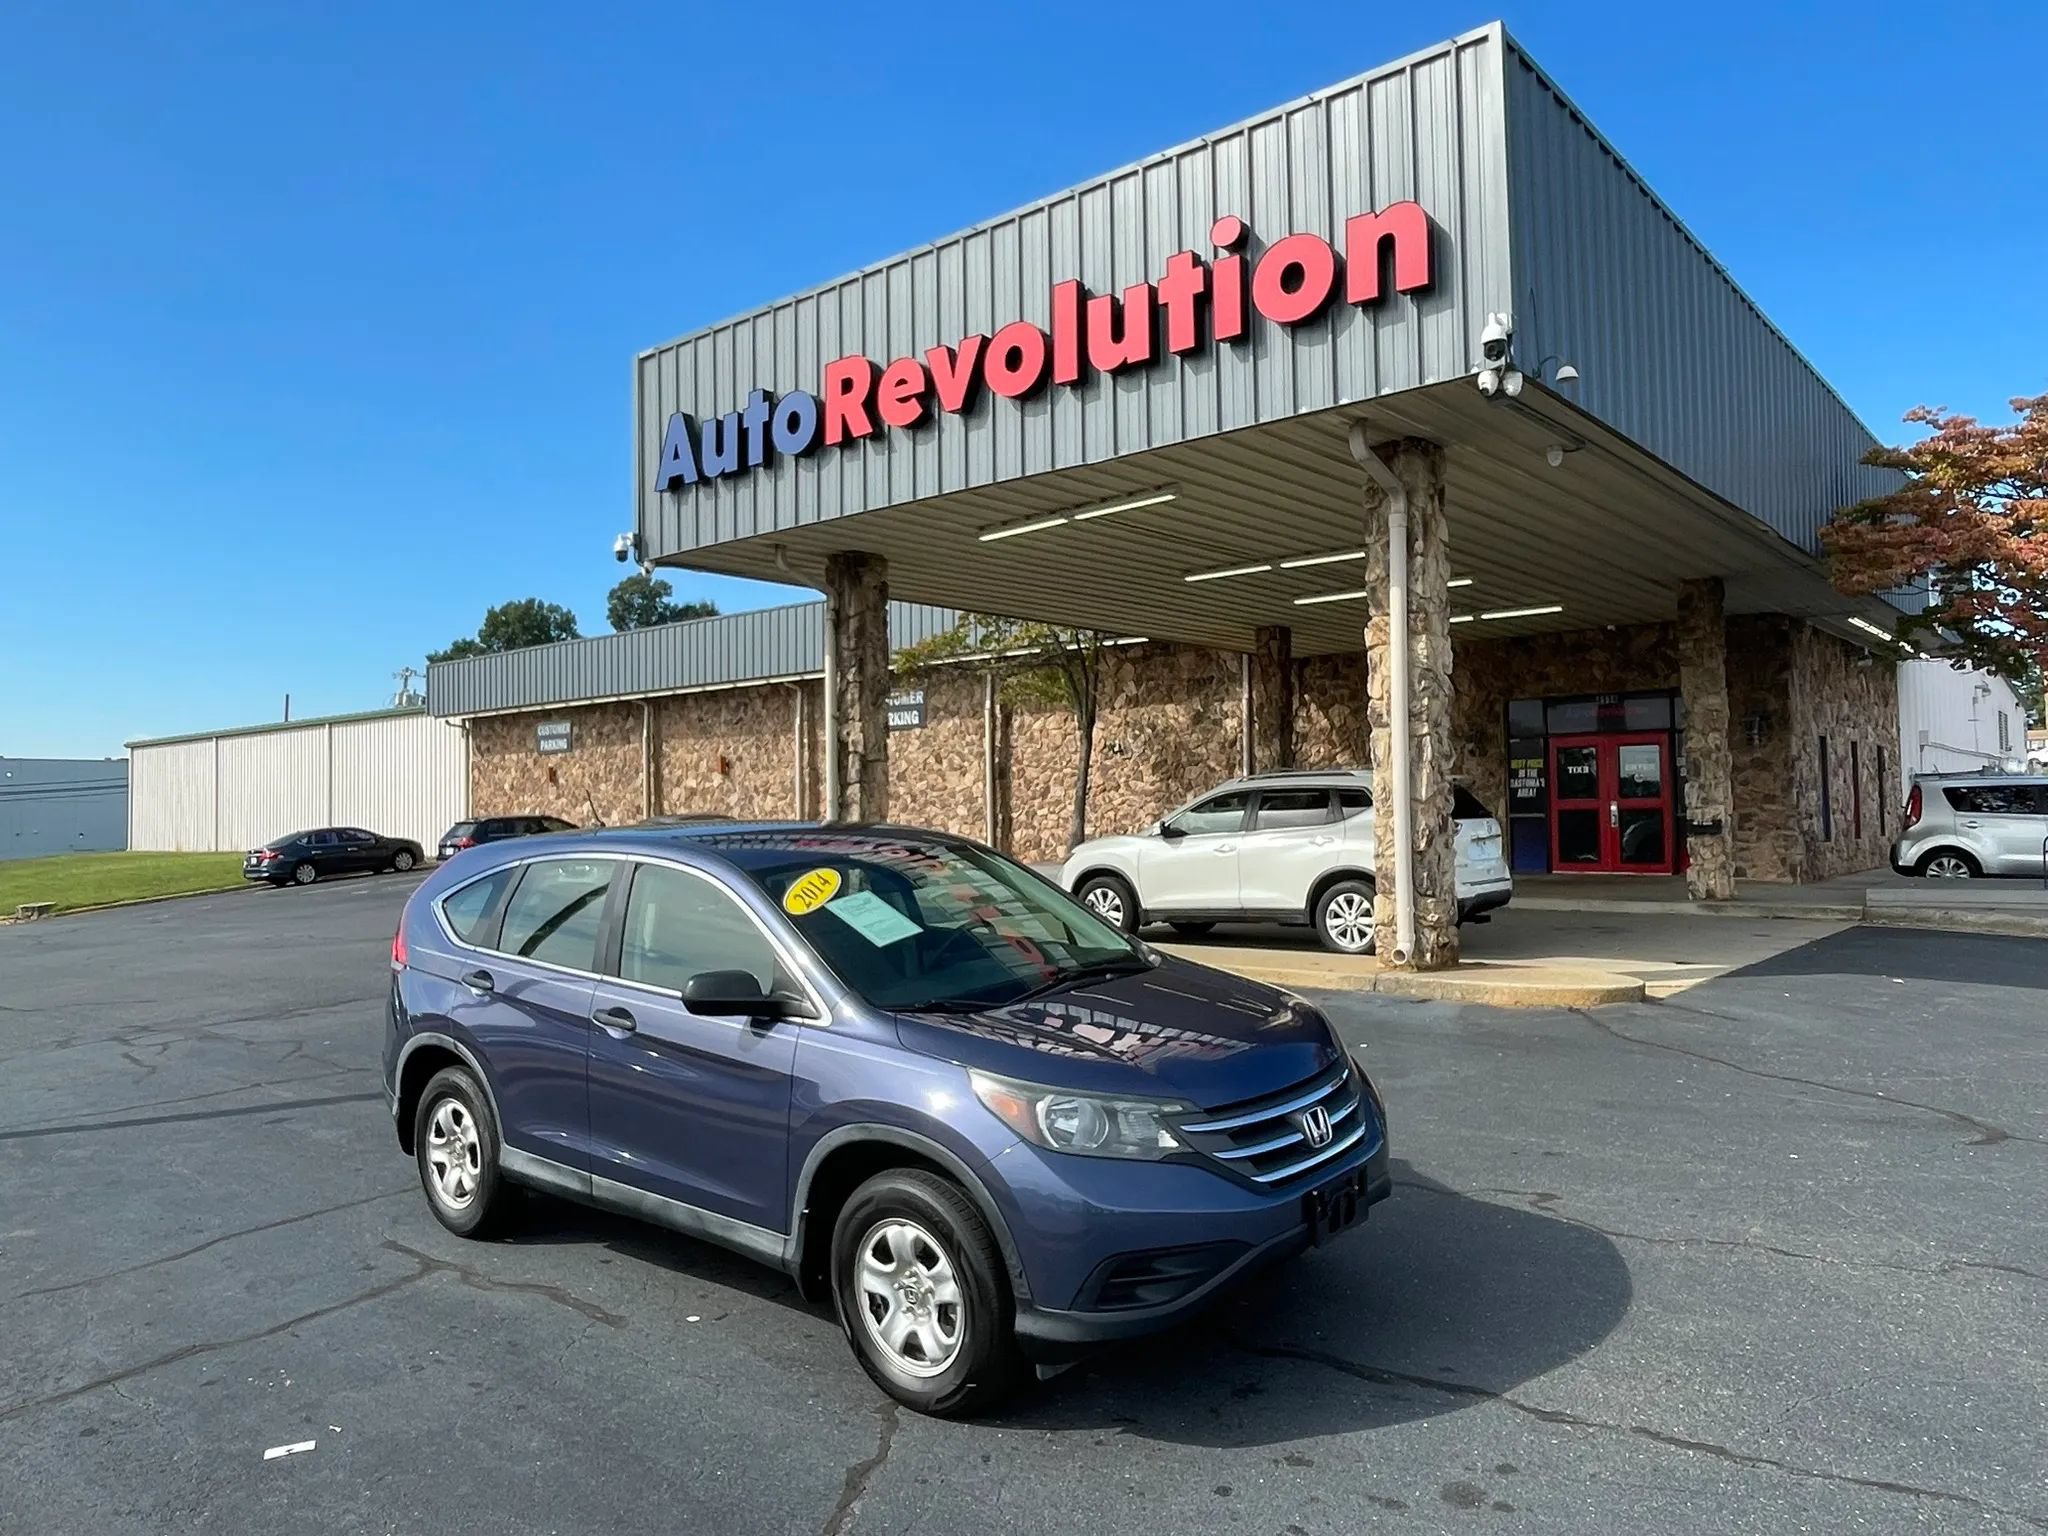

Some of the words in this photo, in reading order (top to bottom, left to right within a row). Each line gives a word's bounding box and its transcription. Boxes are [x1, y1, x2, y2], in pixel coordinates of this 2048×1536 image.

[655, 200, 1434, 492] AutoRevolution
[888, 710, 920, 726] RKING
[537, 723, 571, 736] CUSTOMER
[540, 738, 568, 751] PARKING
[793, 872, 833, 909] 2014
